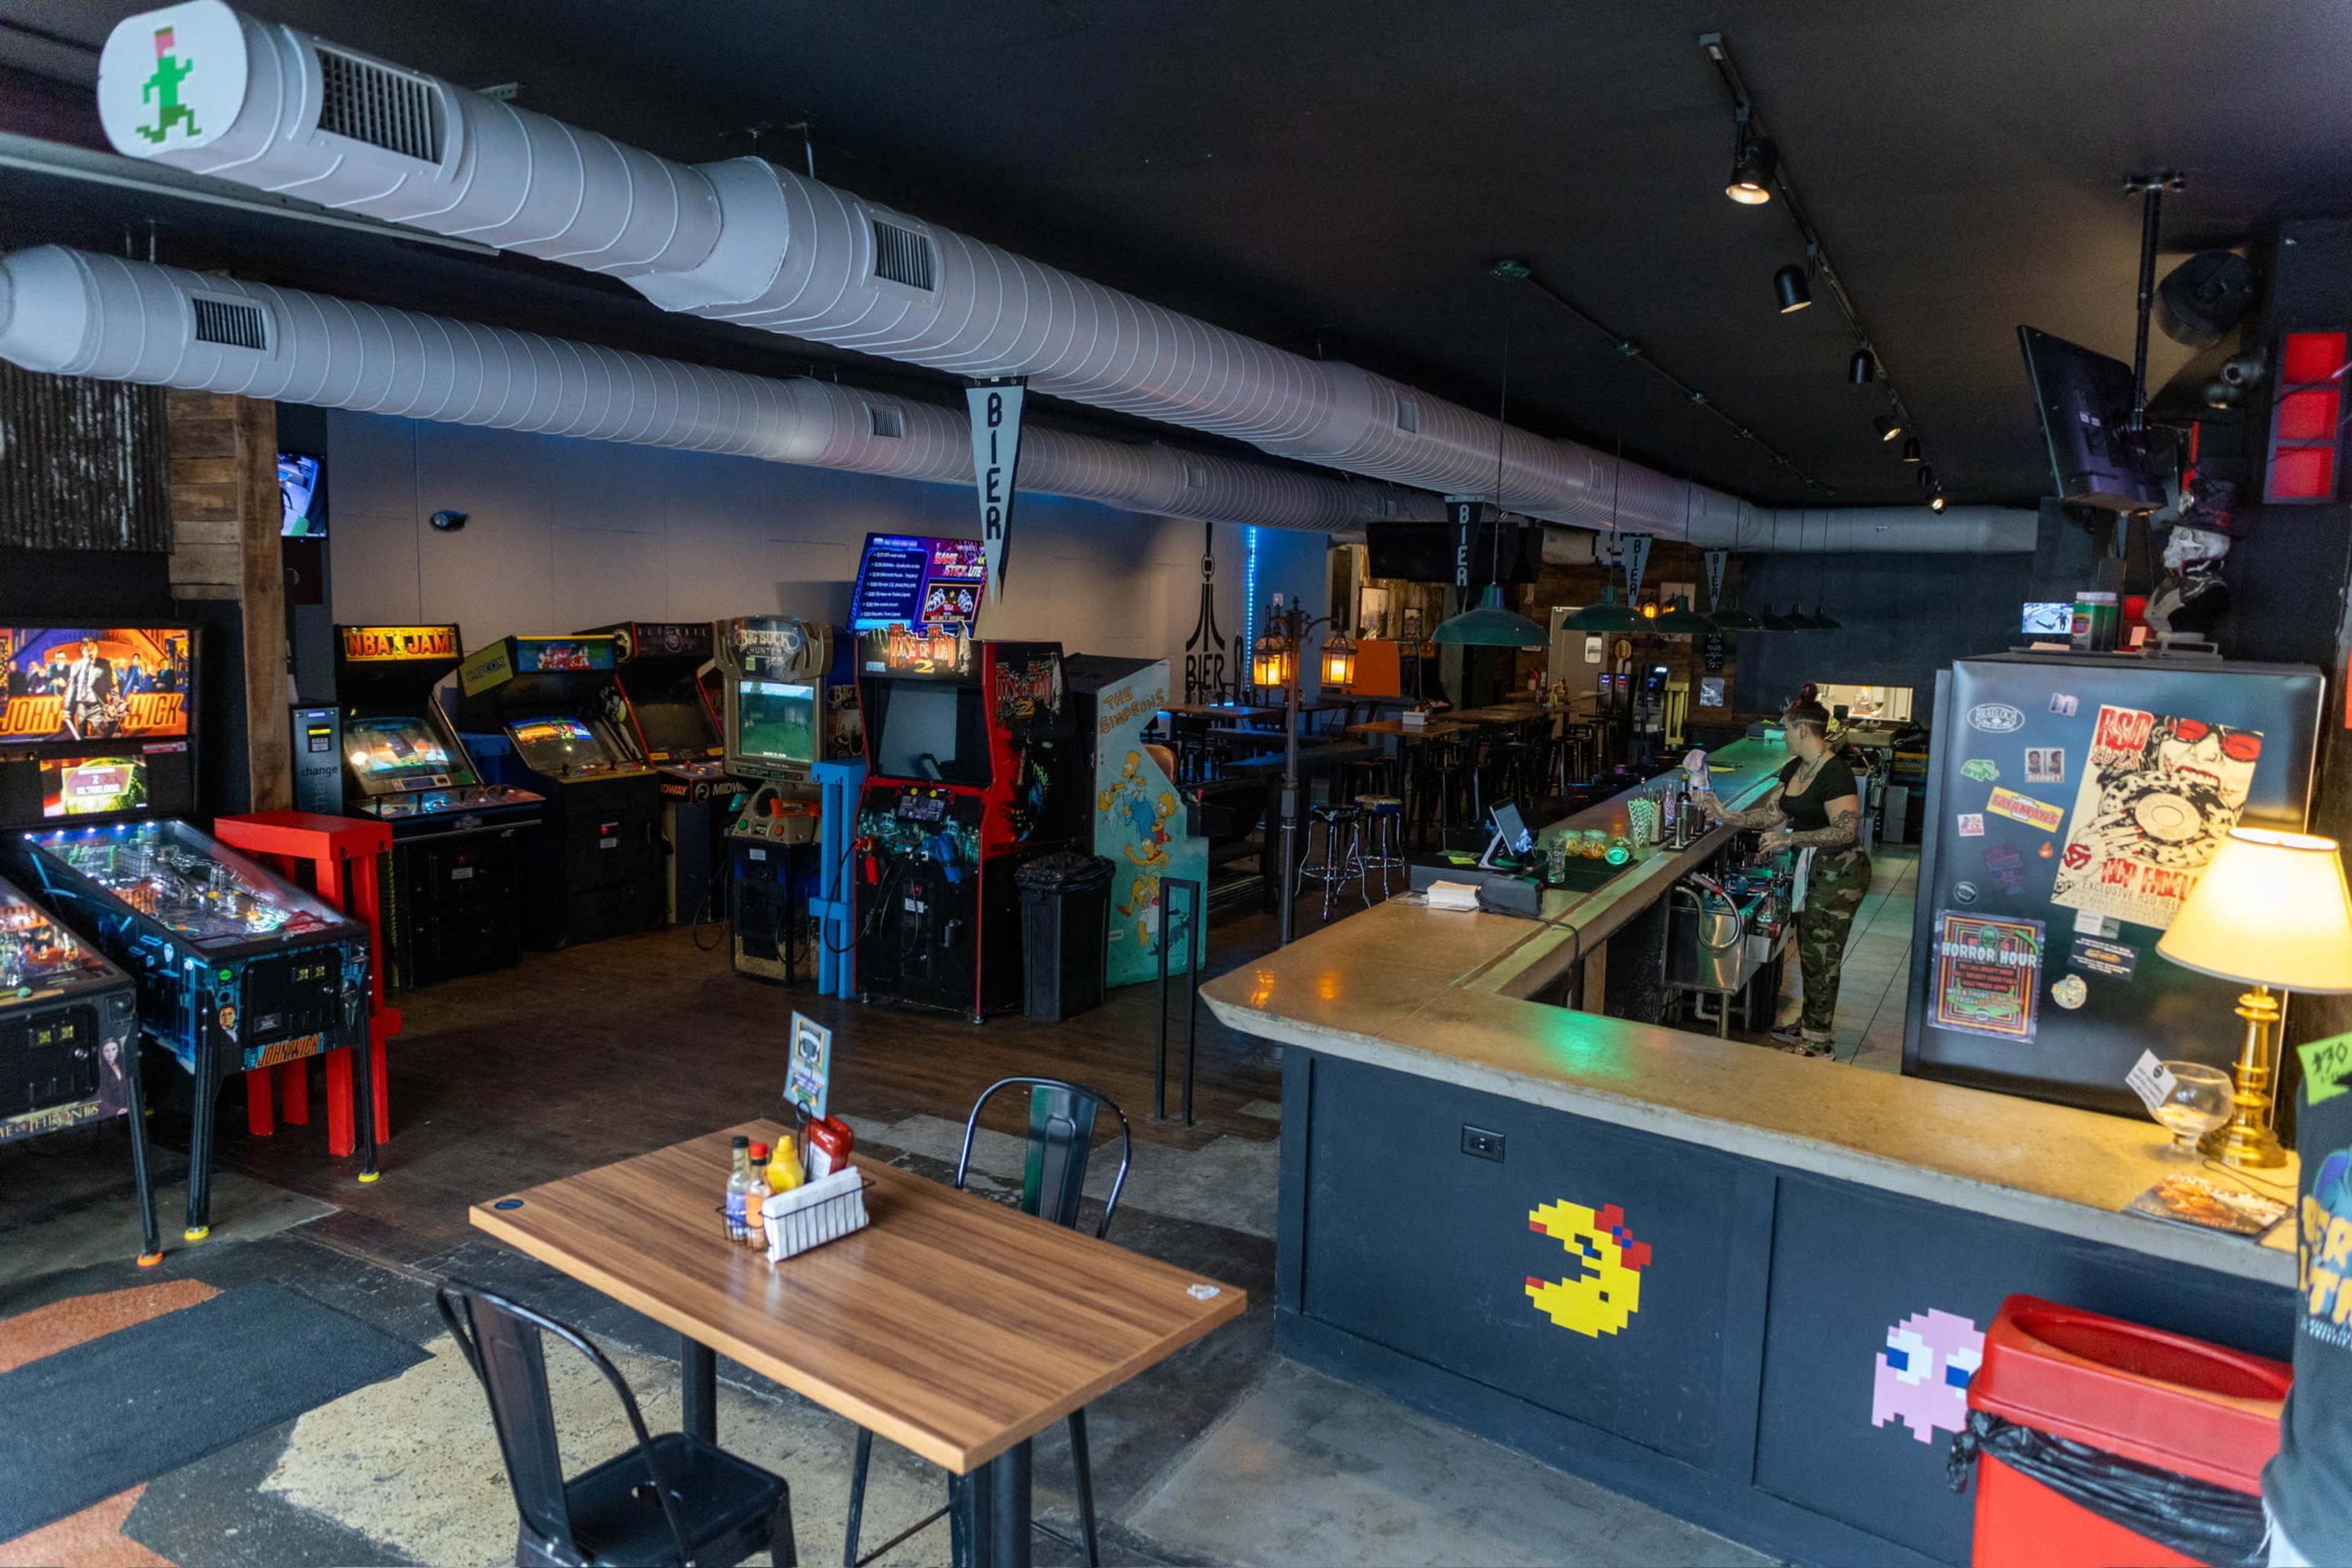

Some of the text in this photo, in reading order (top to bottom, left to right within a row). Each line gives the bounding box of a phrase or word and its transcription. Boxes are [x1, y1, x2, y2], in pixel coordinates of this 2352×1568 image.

[987, 393, 1001, 540] BIER
[1457, 504, 1469, 586] BIER
[968, 566, 983, 577] LITE
[1630, 539, 1642, 596] BIER
[347, 630, 452, 656] NBA JAM
[740, 630, 789, 647] BIG BUCK
[749, 646, 782, 655] HUNTER
[914, 659, 935, 673] 2
[1186, 654, 1224, 690] BIER
[1016, 699, 1035, 718] 2
[1104, 685, 1134, 709] THE
[0, 693, 183, 734] JOHN WICK
[1098, 687, 1164, 734] SIMPSONS
[2096, 708, 2154, 751] RSD
[301, 766, 338, 777] change
[2090, 747, 2141, 770] 2023
[2082, 881, 2134, 900] EXCLUSIVE
[1941, 941, 2037, 968] HORROR HOUR
[257, 1034, 320, 1066] JOHN WICK
[29, 1102, 99, 1133] THRONES
